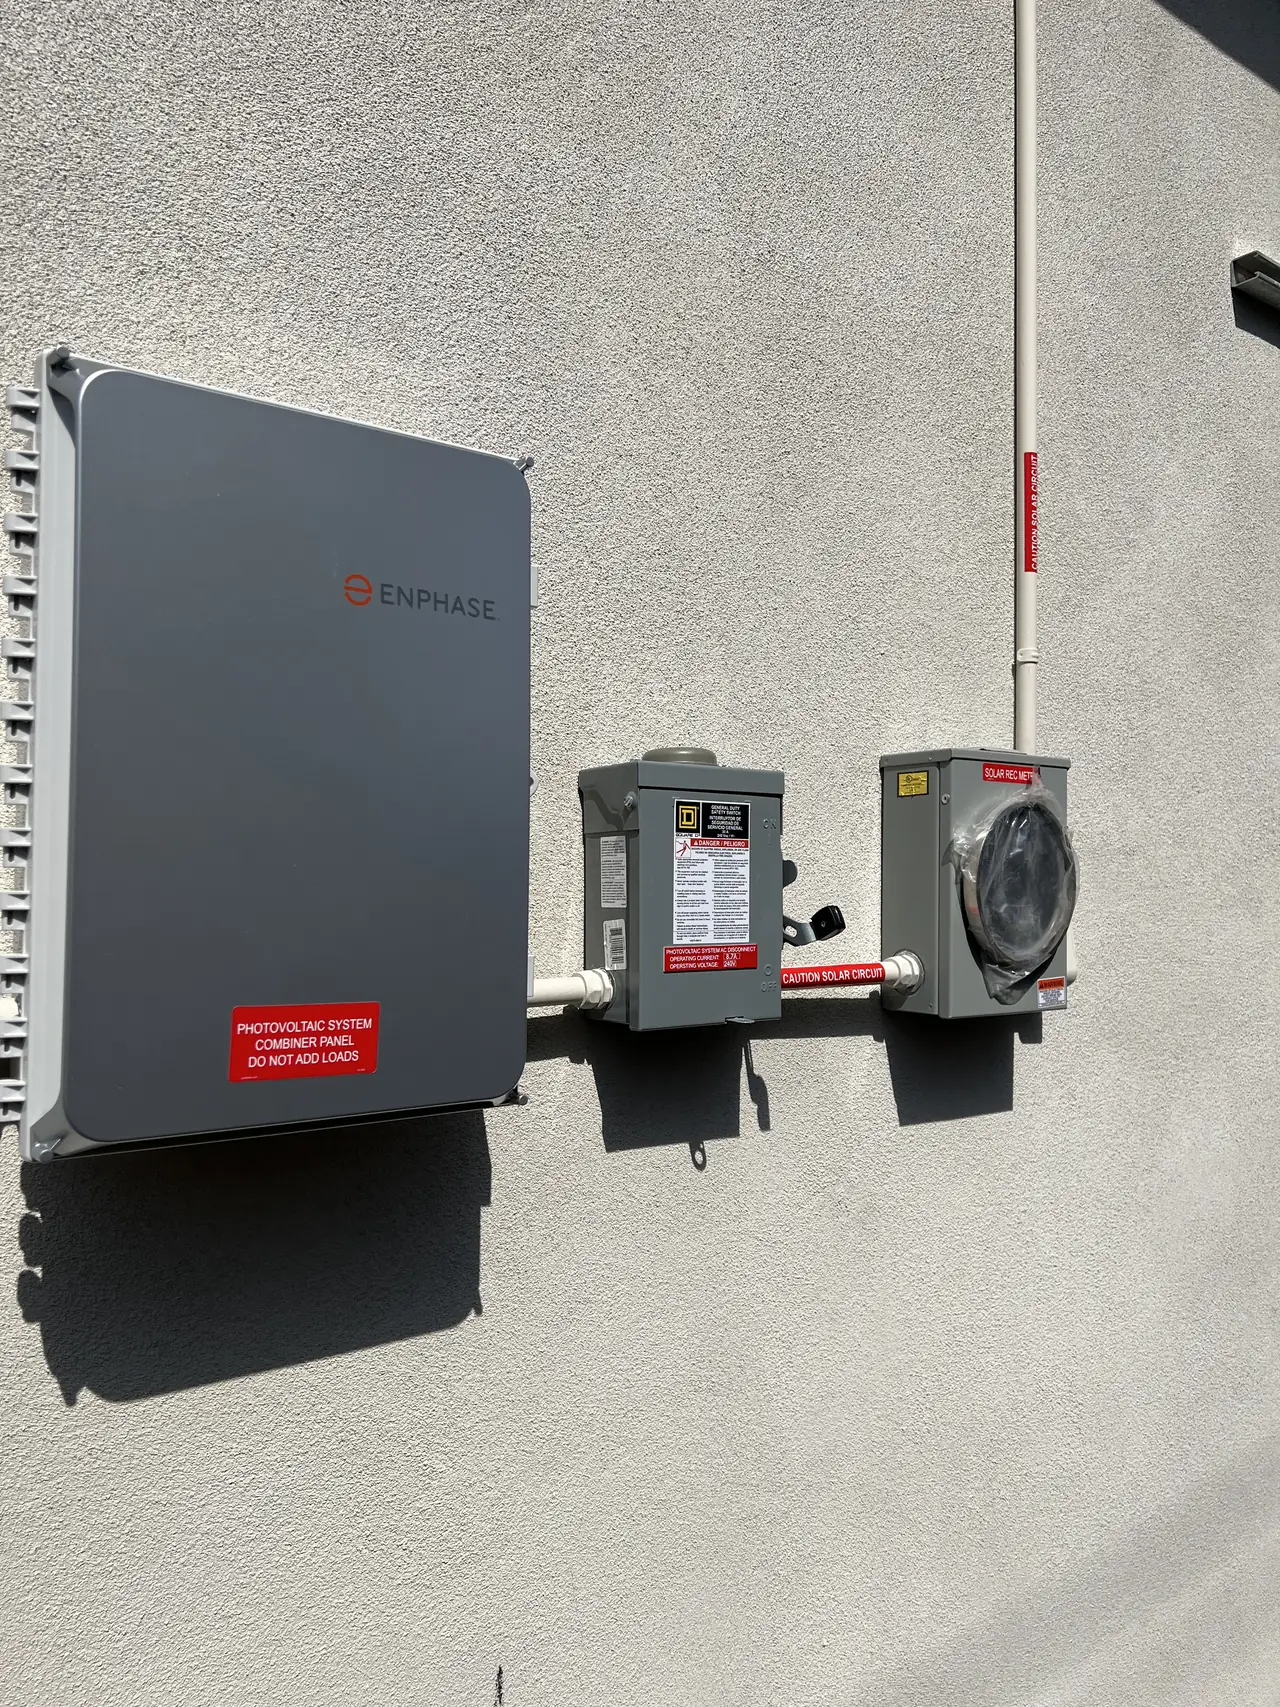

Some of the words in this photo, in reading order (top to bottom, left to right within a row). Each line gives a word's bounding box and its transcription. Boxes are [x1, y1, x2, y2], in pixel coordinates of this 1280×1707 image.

[380, 582, 497, 621] ENPHASE
[984, 767, 1005, 779] SOLAR
[1006, 769, 1018, 780] REC
[724, 840, 746, 848] PELIGRO
[782, 972, 820, 984] CAUTION
[822, 969, 850, 982] SOLAR
[852, 967, 883, 980] CIRCUIT
[236, 1020, 326, 1035] PHOTOVOLTAIC
[327, 1017, 372, 1031] SYSTEM
[254, 1036, 317, 1051] COMBINER
[319, 1034, 355, 1047] PANEL
[247, 1055, 267, 1068] DO
[269, 1053, 294, 1067] NOT
[295, 1052, 320, 1065] ADD
[322, 1050, 360, 1064] LOADS
